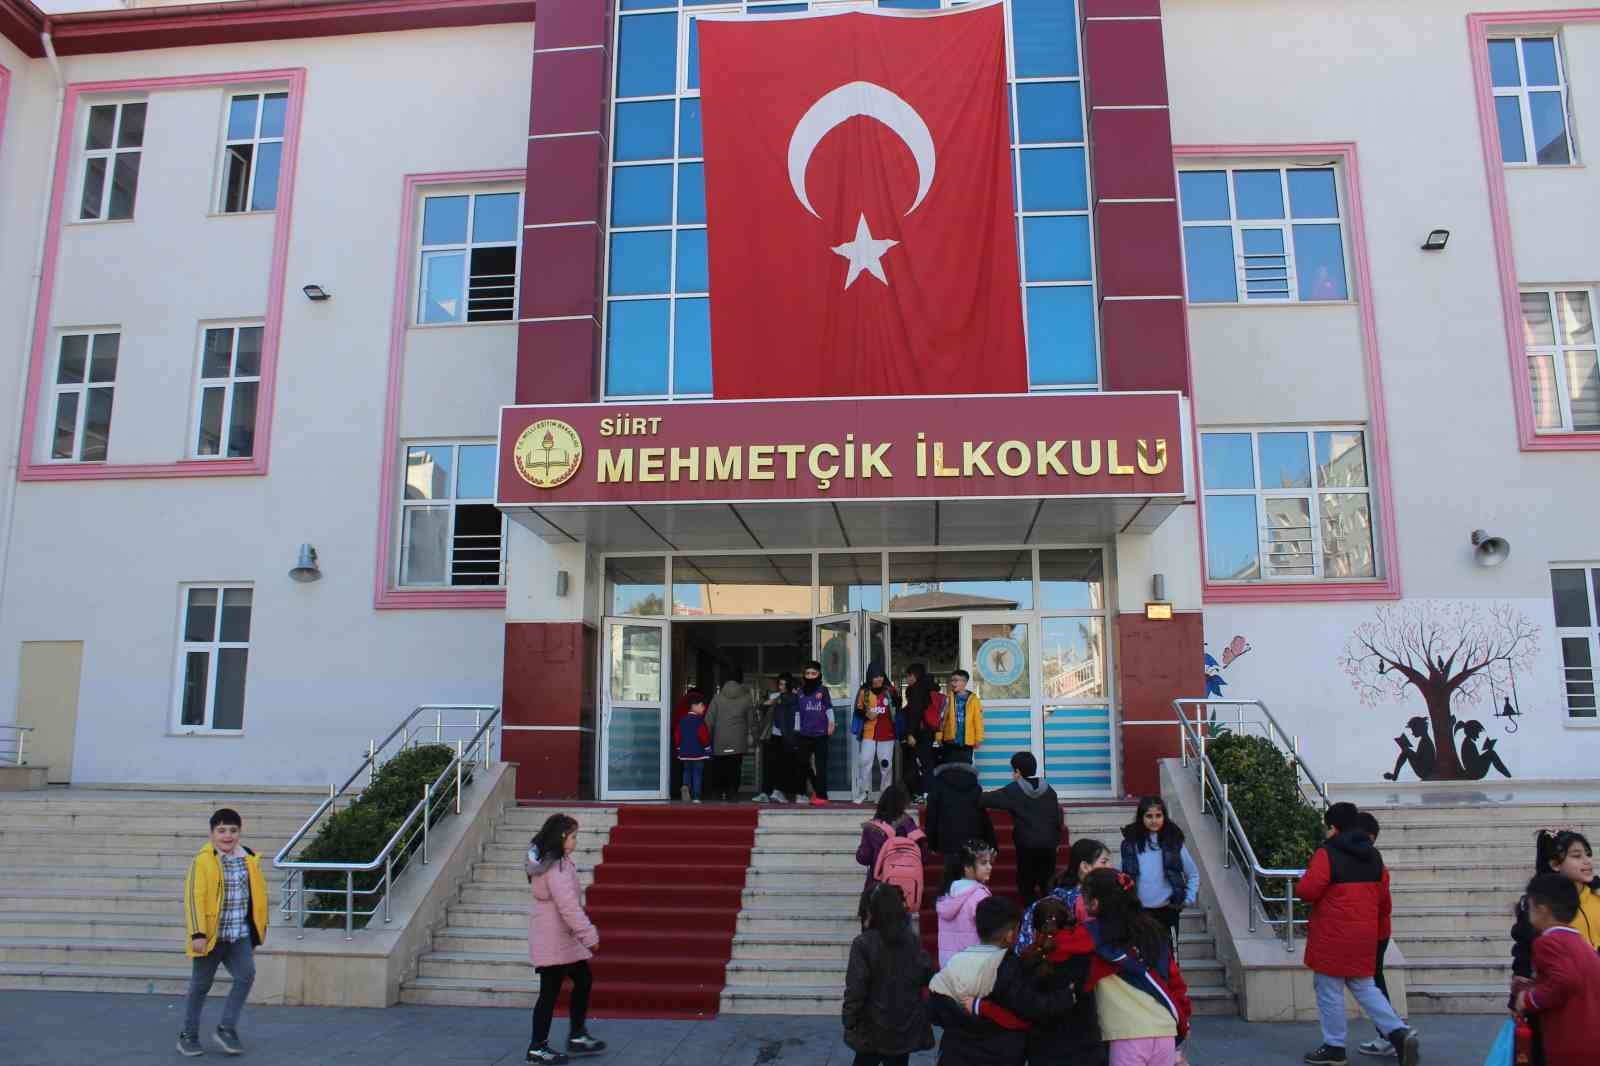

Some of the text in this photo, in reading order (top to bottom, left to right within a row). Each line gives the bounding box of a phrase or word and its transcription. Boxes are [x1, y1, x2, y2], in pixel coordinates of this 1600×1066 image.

[600, 413, 663, 436] SİİRT
[597, 433, 893, 490] MEHMETÇİK
[916, 432, 1168, 477] İLKOKULU
